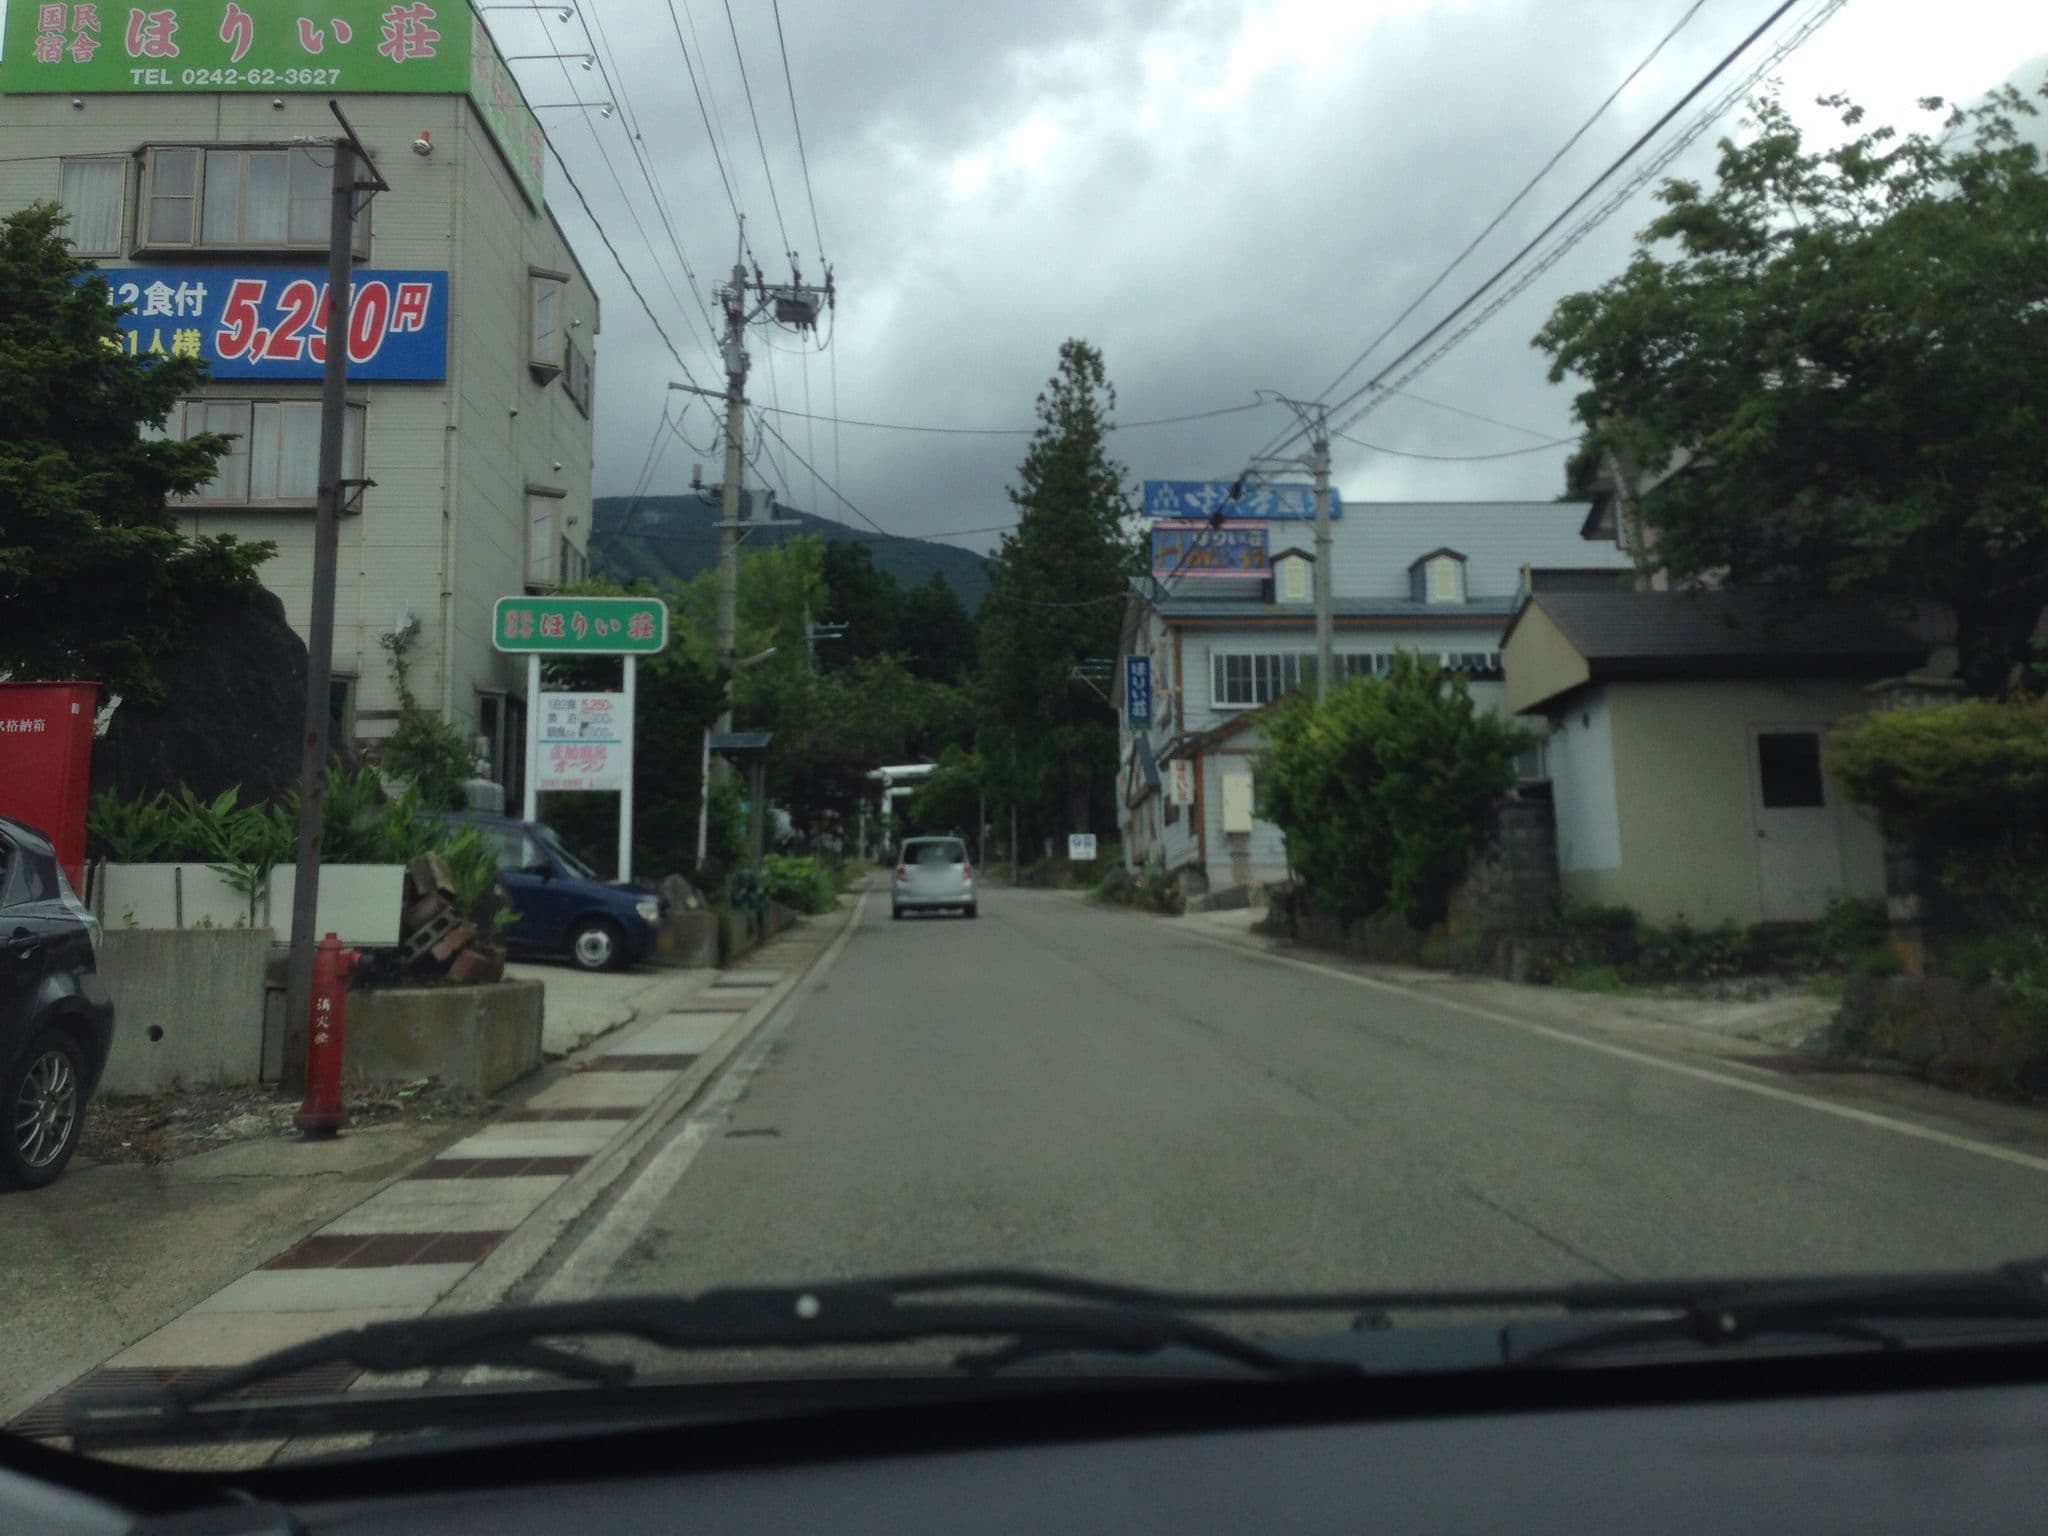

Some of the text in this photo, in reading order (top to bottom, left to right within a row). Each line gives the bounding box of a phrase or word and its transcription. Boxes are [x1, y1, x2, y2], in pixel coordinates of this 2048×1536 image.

[37, 3, 101, 32] 国民
[125, 2, 441, 63] ほりい荘
[33, 32, 101, 63] 宿舎
[130, 69, 341, 85] TEL 0242-62-3627
[106, 280, 208, 317] 2食付
[540, 611, 656, 641] ほりい荘
